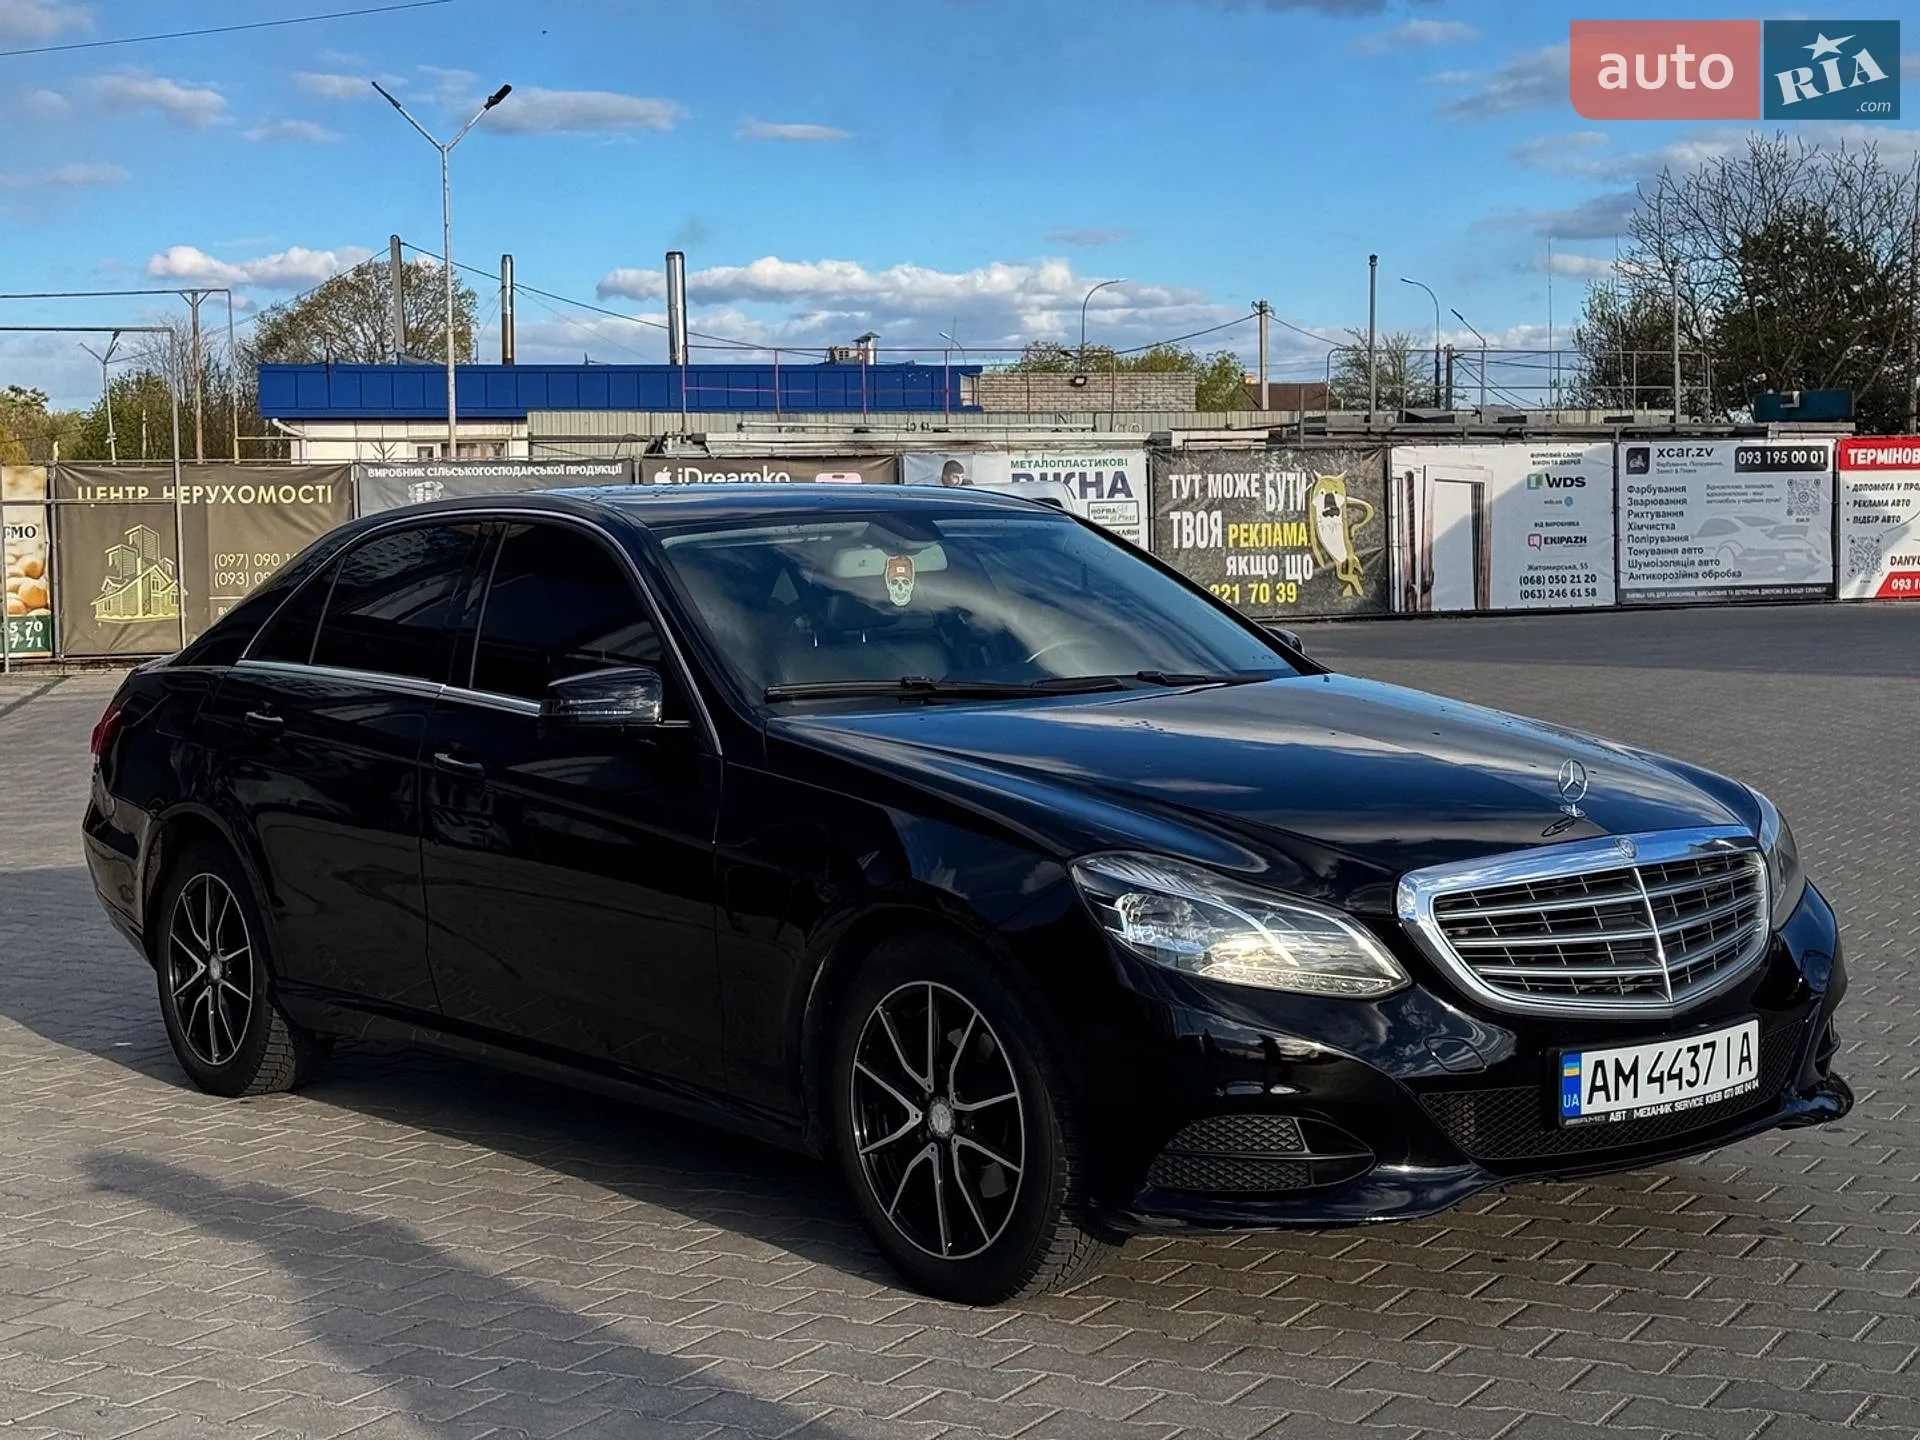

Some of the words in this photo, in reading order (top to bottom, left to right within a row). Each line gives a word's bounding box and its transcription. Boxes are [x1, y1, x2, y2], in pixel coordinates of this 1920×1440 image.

[1656, 447, 1714, 458] xcar.zv
[1738, 451, 1761, 464] 093
[1766, 451, 1788, 464] 195
[1791, 451, 1807, 464] 00
[1810, 451, 1824, 464] 01
[1010, 458, 1128, 468] МЕТАЛОПЛАСТИКОВІ
[368, 467, 425, 478] ВИРОБНИК
[427, 464, 565, 477] СІЛЬСЬКОГОСПОДАРСЬКОЇ
[566, 463, 622, 476] ПРОДУКЦІЇ
[1545, 473, 1586, 488] WDS
[78, 486, 149, 500] ЦЕНТР
[163, 484, 332, 504] НЕРУХОМОСТІ
[1169, 474, 1202, 499] ТУТ
[1208, 473, 1260, 498] МОЖЕ
[1266, 471, 1306, 512] БУТИ
[1627, 484, 1687, 494] Фарбування
[1627, 496, 1687, 506] Зварювання
[1891, 499, 1911, 507] АВТО
[1627, 509, 1684, 520] Рихтування
[1881, 515, 1901, 523] АВТО
[1169, 510, 1222, 548] ТВОЯ
[1627, 521, 1676, 530] Хімчистка
[1544, 536, 1587, 544] EKIPAZH
[1627, 533, 1689, 544] Полірування
[214, 553, 249, 570] (097)
[254, 553, 280, 566] 090
[1628, 558, 1695, 569] Шумоізоляція
[1226, 554, 1279, 579] ЯКЩО
[1285, 554, 1314, 585] ЩО
[1628, 571, 1699, 581] Антикорозійна
[1701, 569, 1742, 579] обробка
[214, 571, 250, 588] (093)
[1519, 575, 1545, 586] (068)
[1548, 575, 1567, 584] 050
[1569, 575, 1582, 583] 21
[1584, 574, 1597, 583] 20
[1891, 578, 1912, 591] 093
[1248, 582, 1270, 604] 70
[1276, 582, 1297, 603] 39
[1519, 589, 1546, 600] (063)
[1548, 589, 1568, 598] 246
[1570, 588, 1582, 597] 61
[1584, 587, 1597, 597] 58
[25, 621, 43, 632] 70
[27, 637, 42, 648] 71
[1587, 1055, 1639, 1105] AM
[1647, 1040, 1716, 1095] 4437
[1726, 1031, 1752, 1079] IA
[1563, 1094, 1579, 1108] UA
